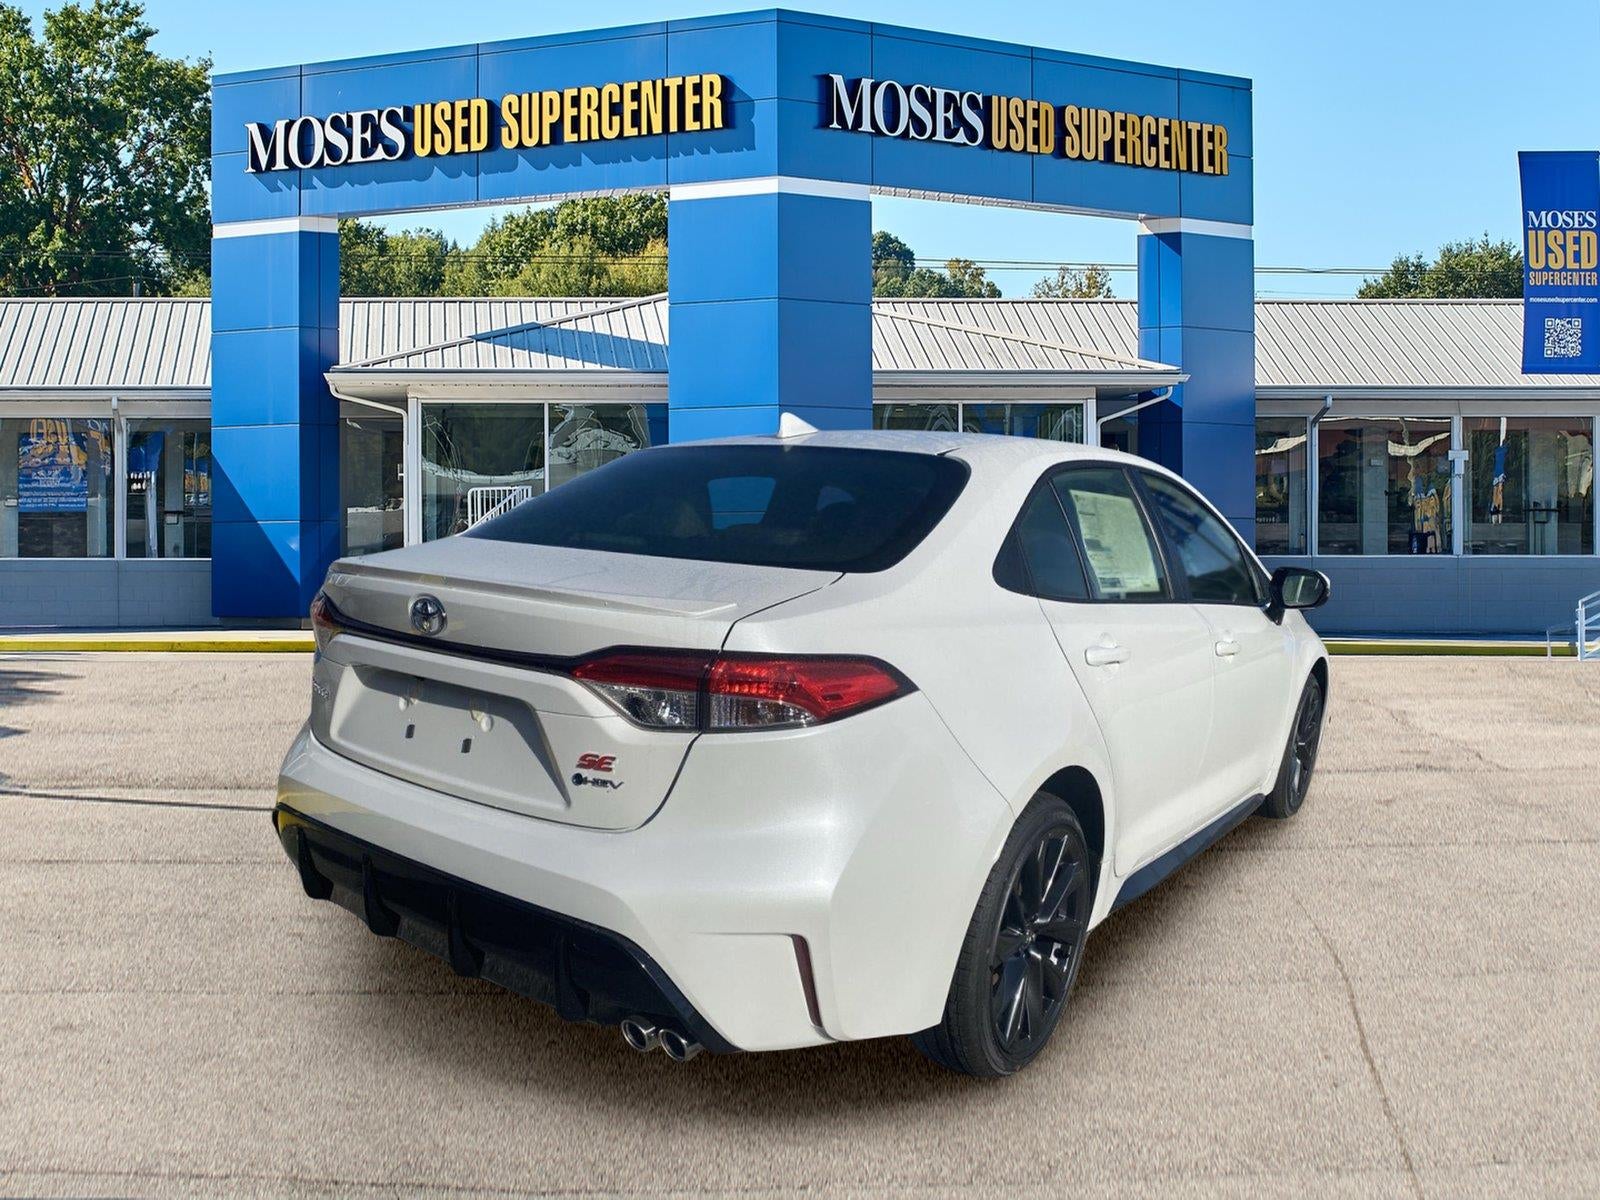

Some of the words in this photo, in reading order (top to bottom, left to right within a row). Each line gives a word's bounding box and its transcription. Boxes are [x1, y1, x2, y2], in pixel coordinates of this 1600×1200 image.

[244, 106, 406, 173] MOSES
[414, 98, 488, 157] USED
[501, 73, 723, 148] SUPERCENTER
[829, 74, 984, 146] MOSES
[991, 95, 1055, 154] USED
[1065, 105, 1229, 175] SUPERCENTER
[1528, 210, 1597, 228] MOSES
[1528, 230, 1597, 269] USED
[1529, 271, 1597, 286] SUPERCENTER
[576, 753, 616, 772] SE
